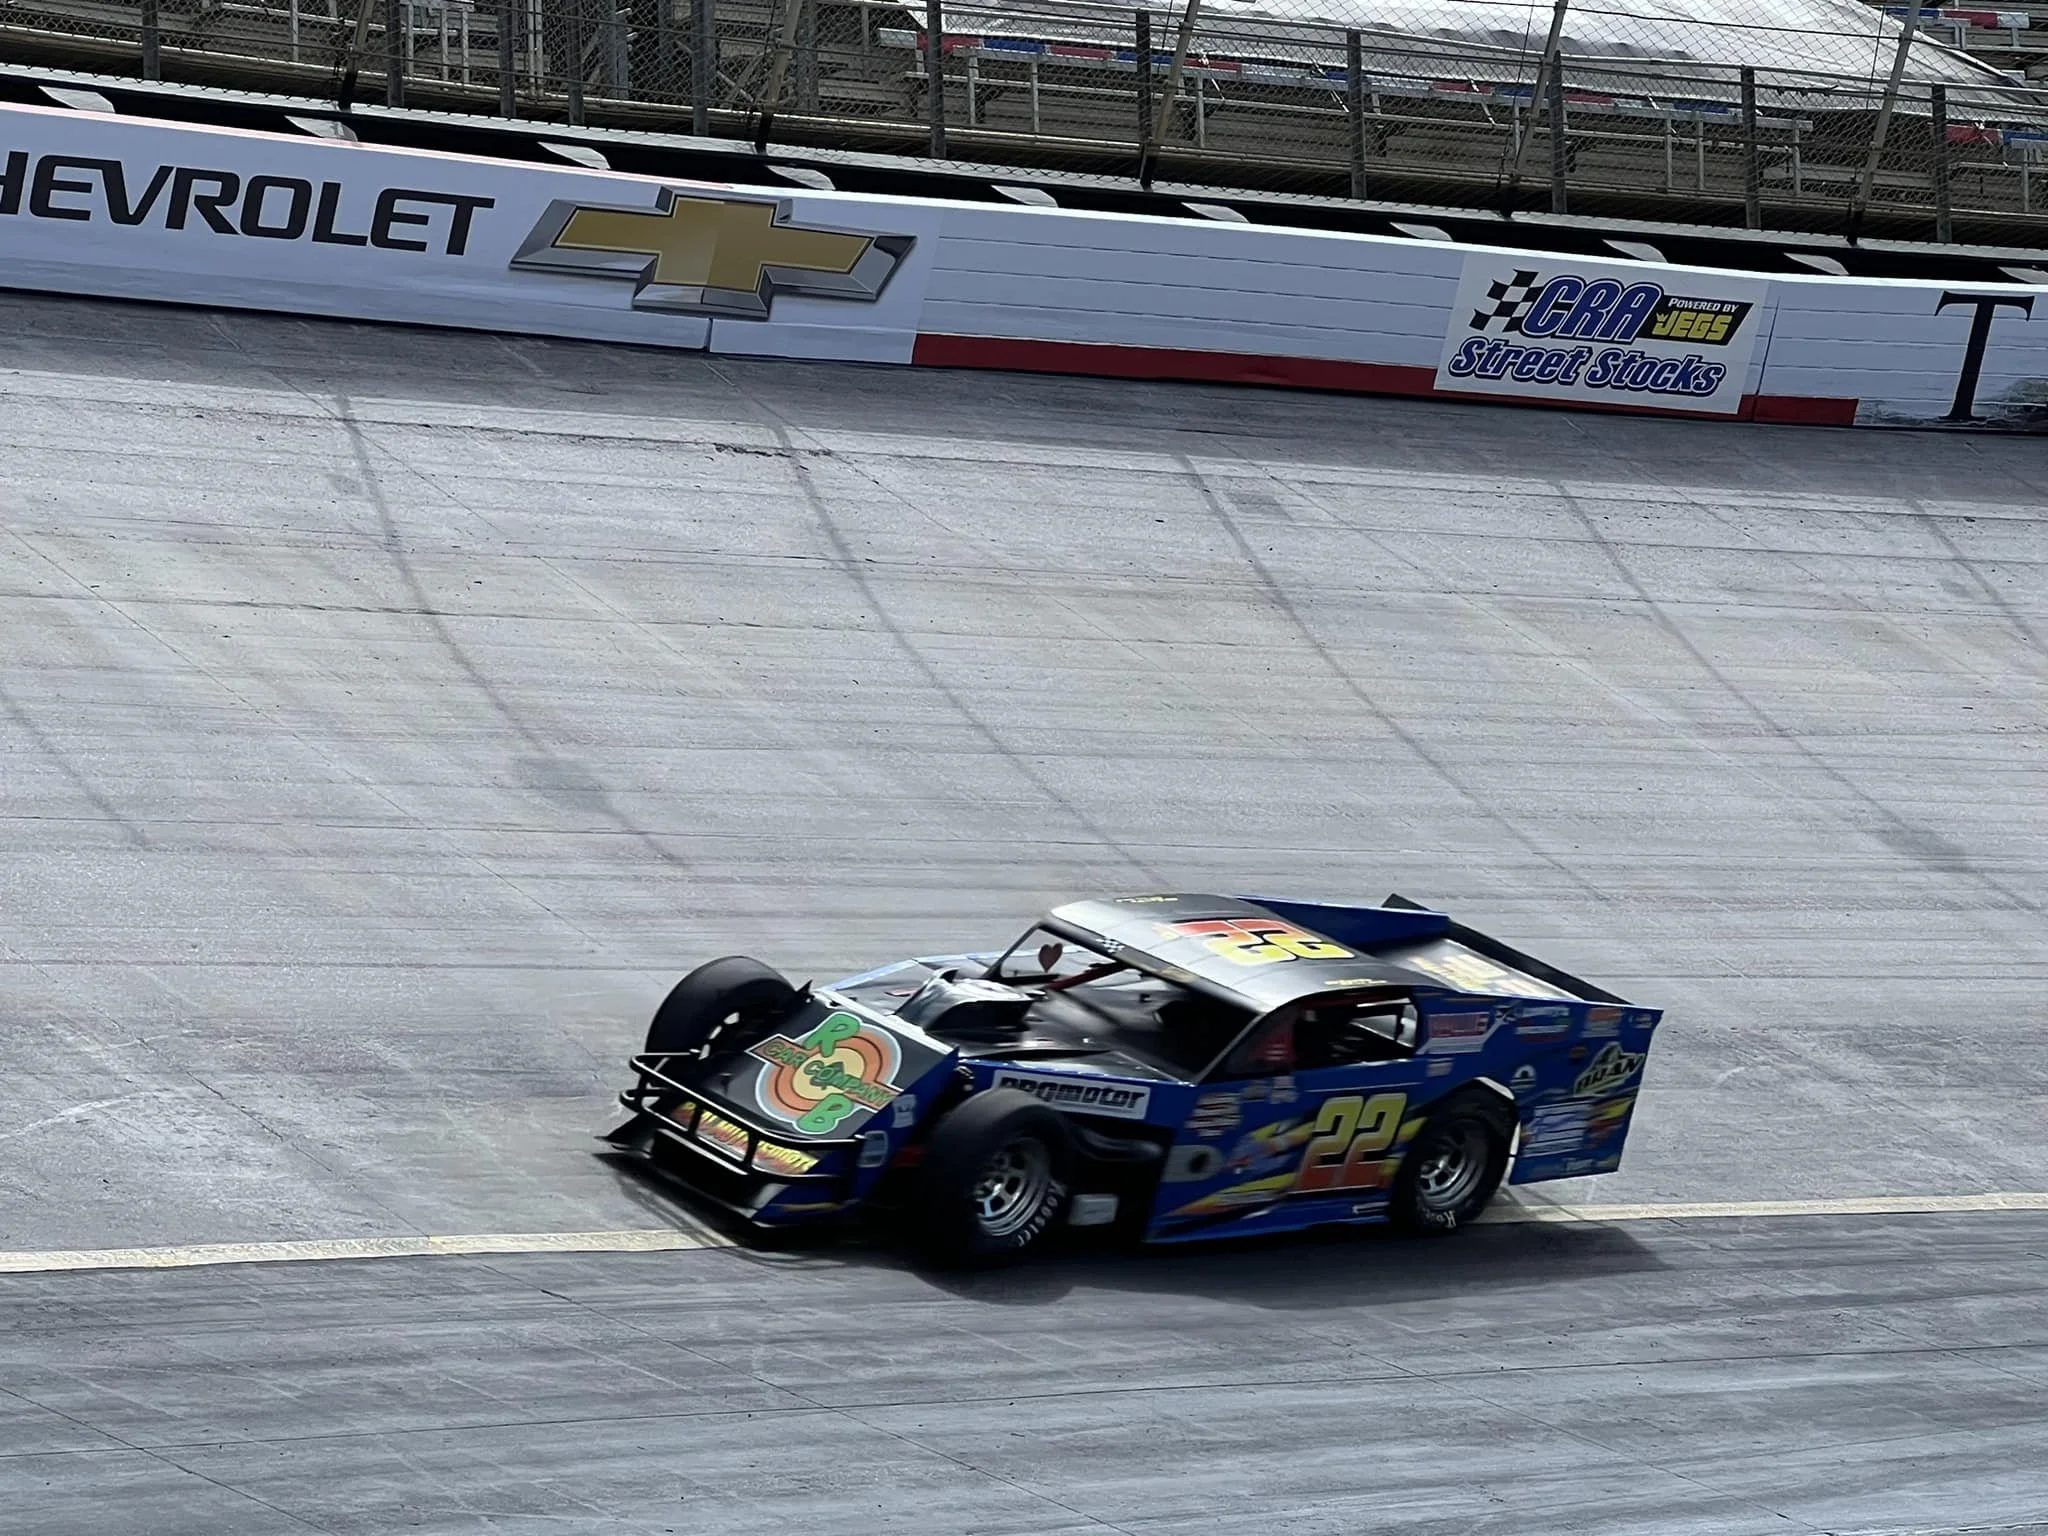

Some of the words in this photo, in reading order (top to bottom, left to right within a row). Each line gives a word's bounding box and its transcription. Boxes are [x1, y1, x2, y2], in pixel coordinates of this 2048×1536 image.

[1518, 275, 1664, 344] CRA
[1652, 310, 1733, 341] JEGS
[1668, 297, 1720, 311] POWERED
[1723, 303, 1740, 313] BY
[1450, 336, 1592, 384] Street
[1585, 346, 1727, 397] Stocks
[1934, 290, 2035, 420] T
[803, 1012, 861, 1058] R
[764, 1041, 809, 1070] CAR
[803, 1060, 896, 1105] COMPANY
[795, 1093, 855, 1133] B
[1290, 1092, 1407, 1193] 22
